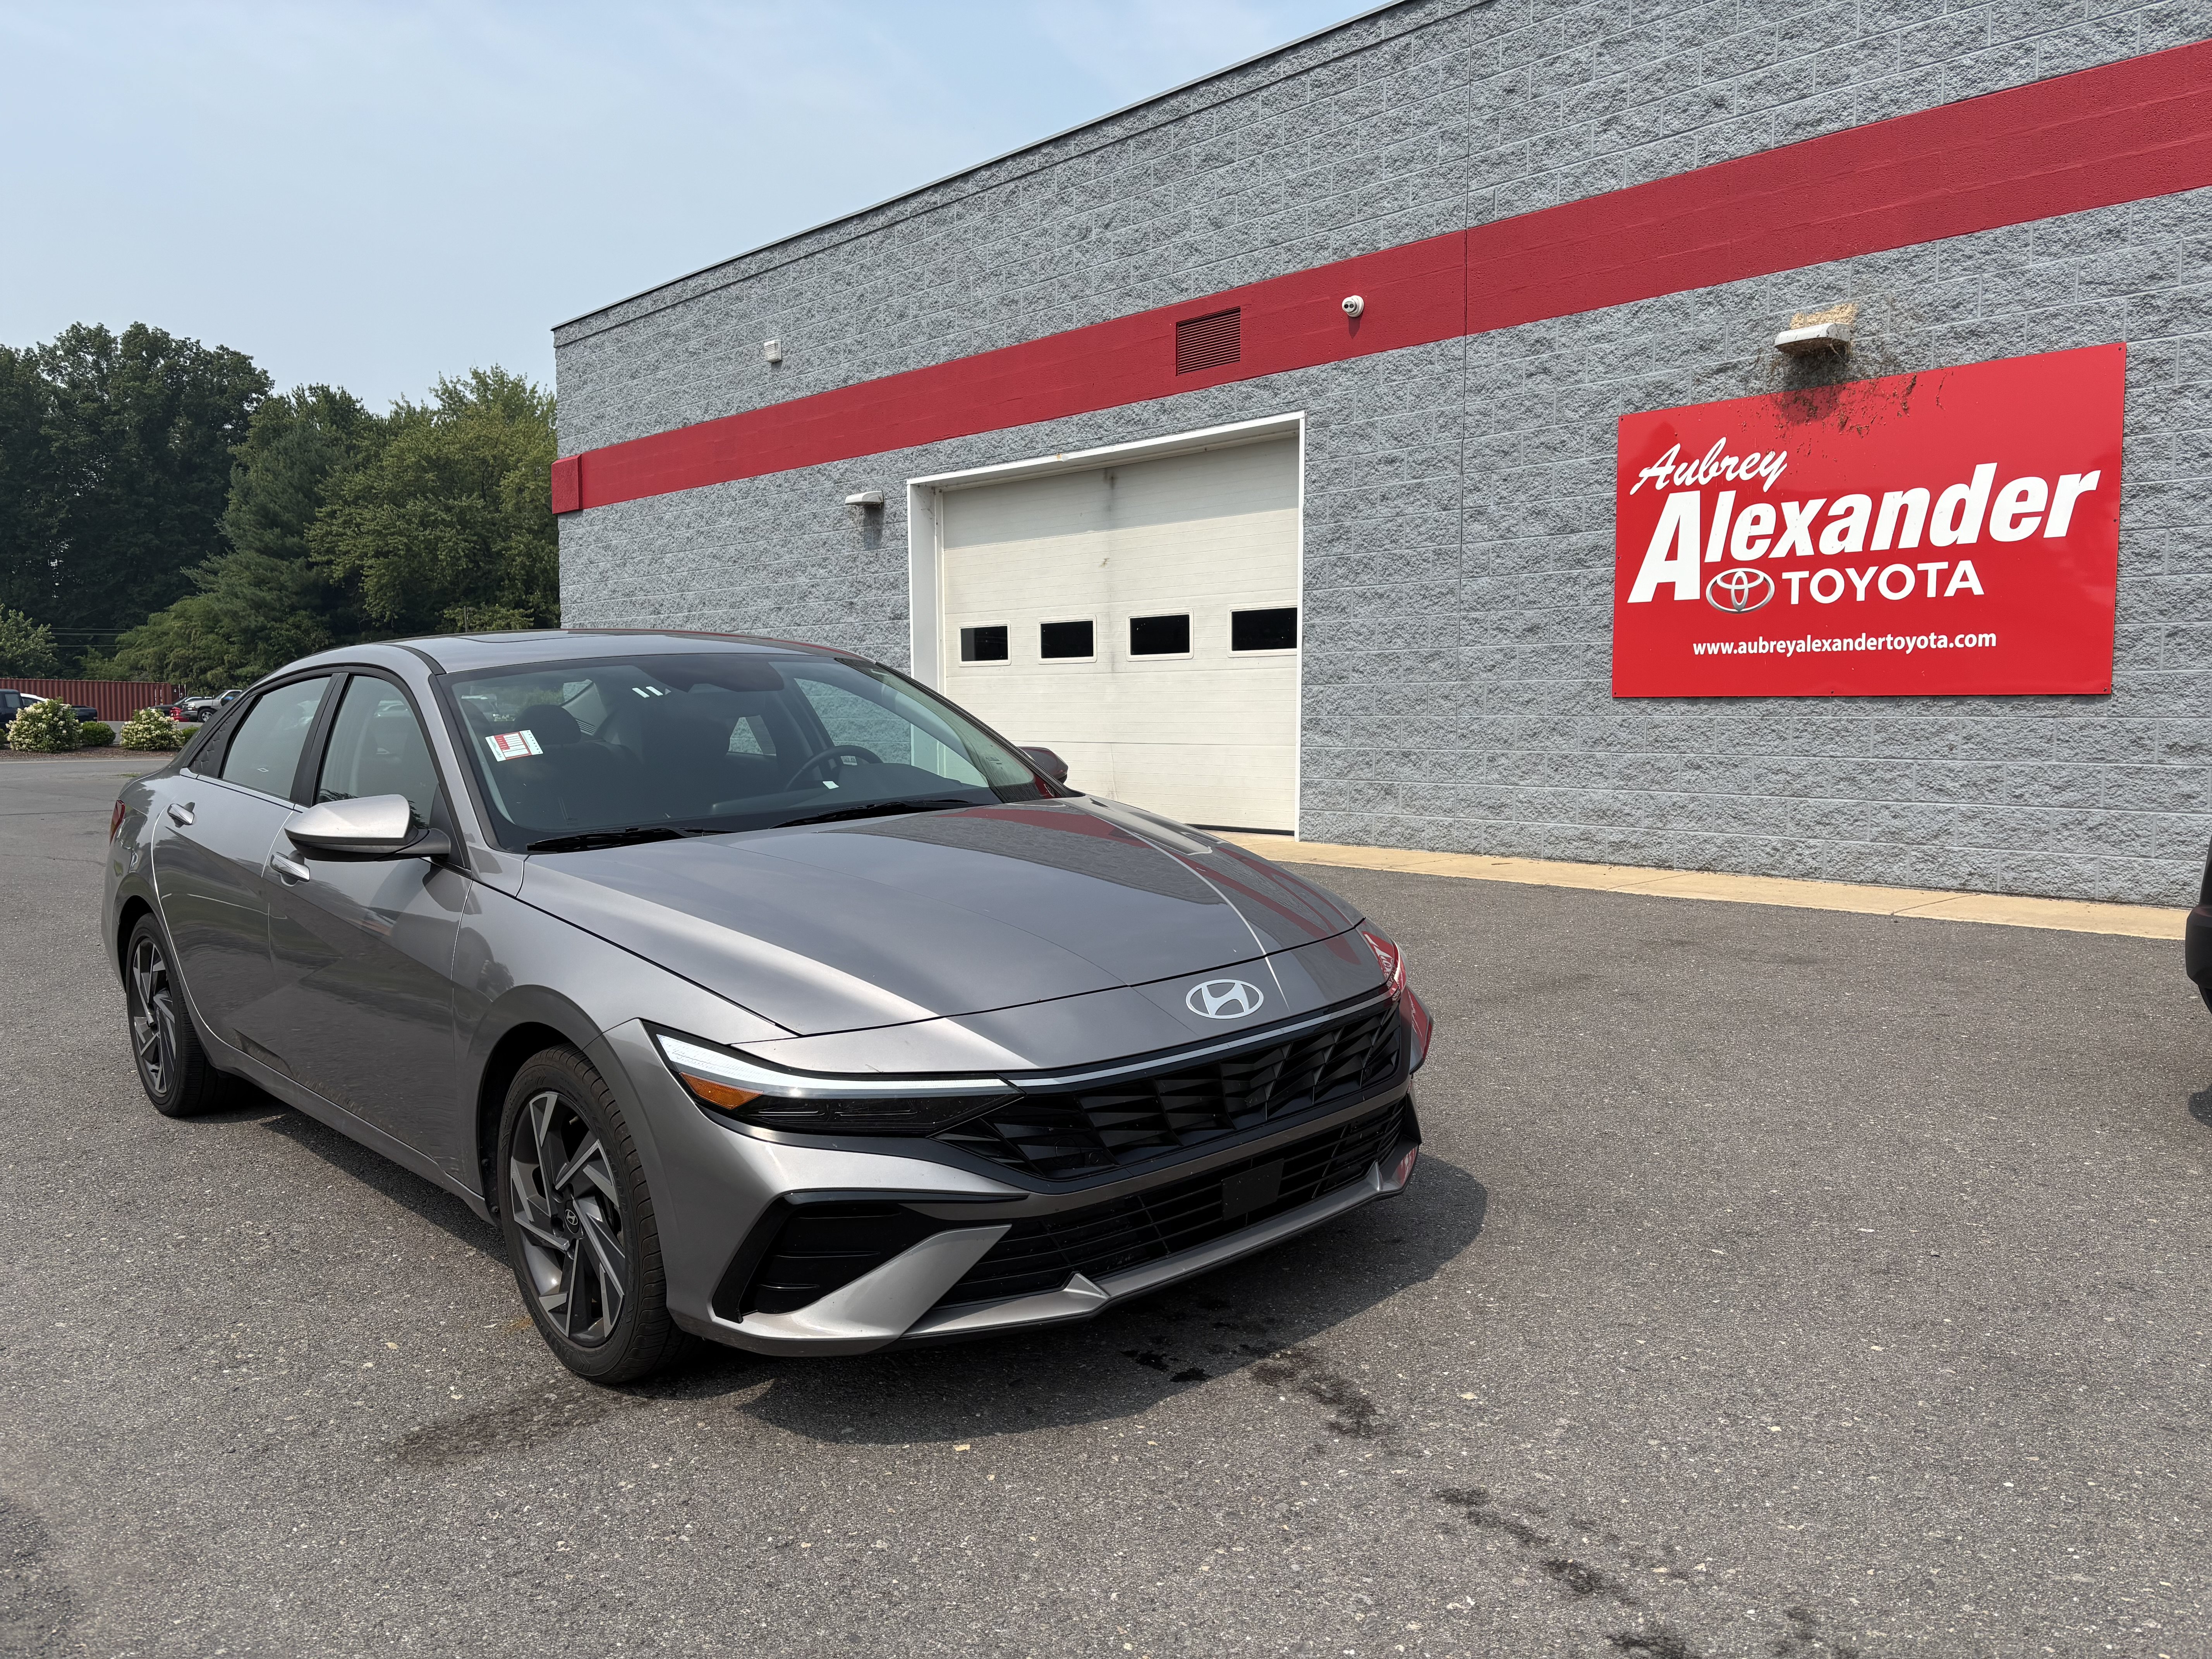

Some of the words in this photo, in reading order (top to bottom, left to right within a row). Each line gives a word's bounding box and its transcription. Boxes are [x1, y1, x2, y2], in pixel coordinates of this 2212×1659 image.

[1630, 437, 1788, 496] Aubrey
[1627, 462, 2101, 603] Alexander
[1782, 560, 1984, 605] TOYOTA
[1693, 632, 1996, 658] www.aubreyalexandertoyota.com
